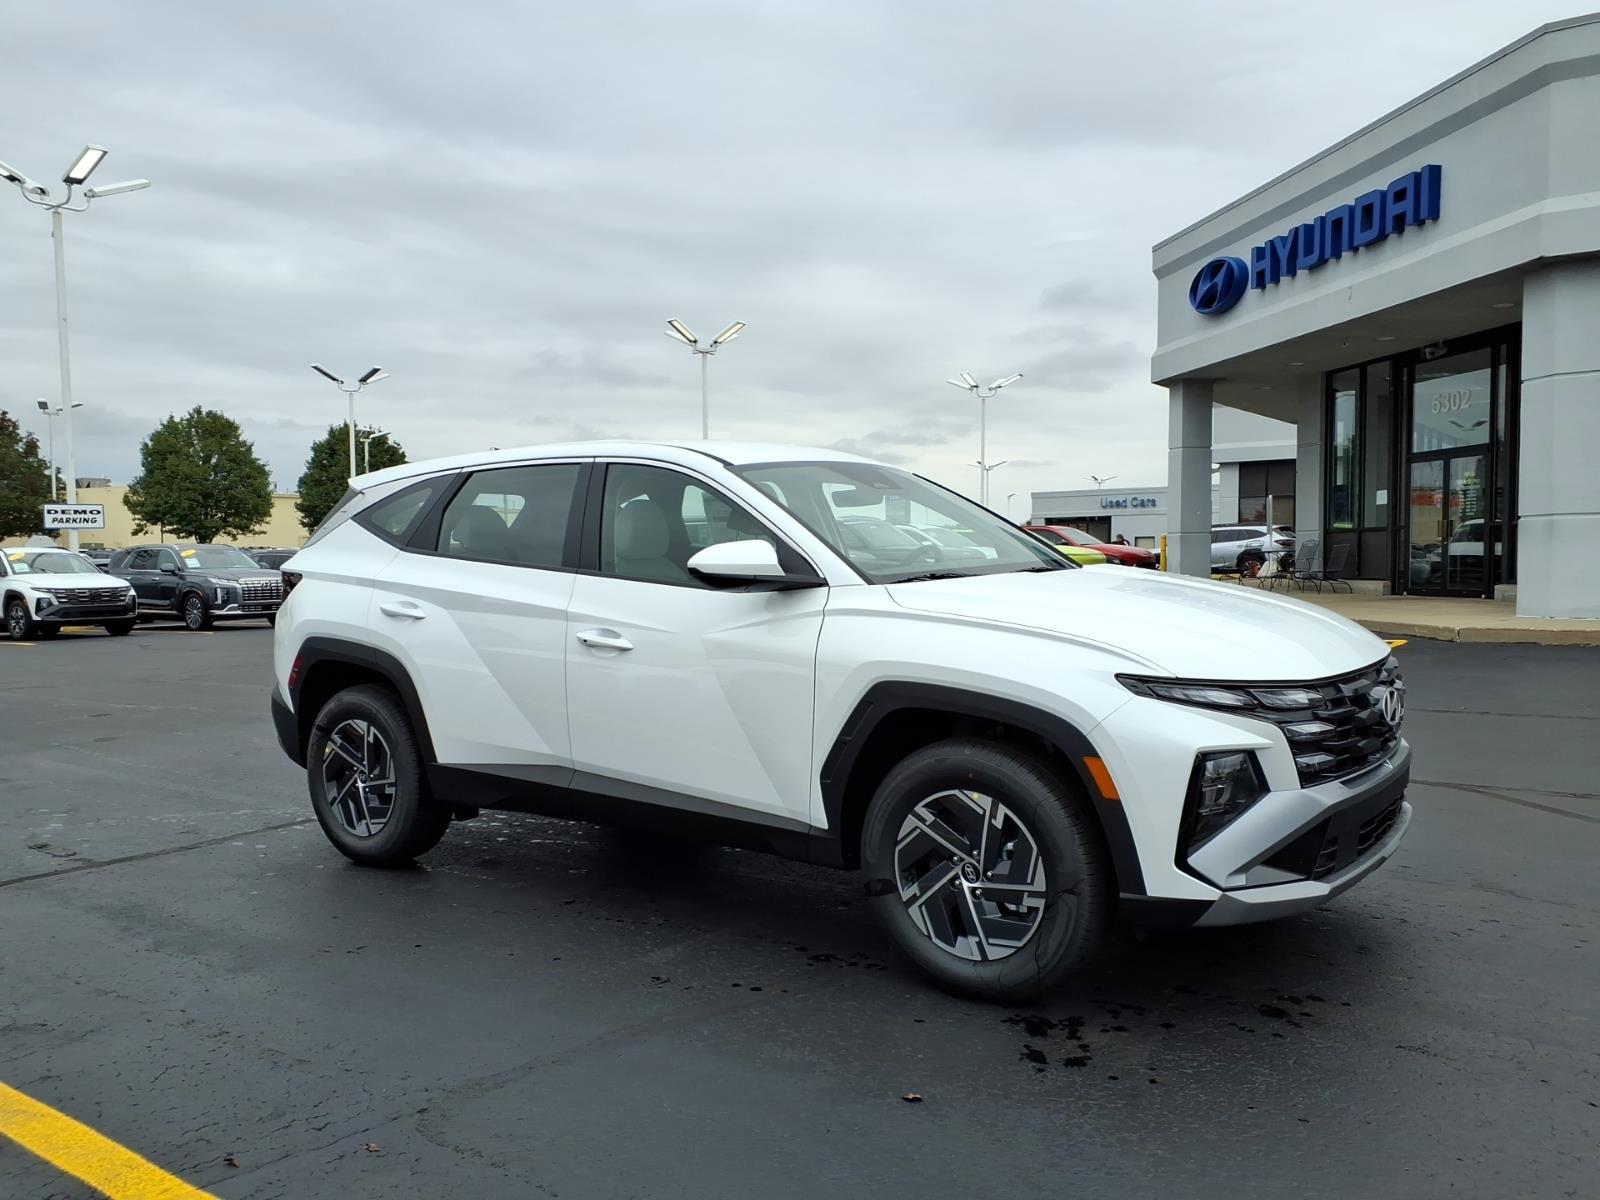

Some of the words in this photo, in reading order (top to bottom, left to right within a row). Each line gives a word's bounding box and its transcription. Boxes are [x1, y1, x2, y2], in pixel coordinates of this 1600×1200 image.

[1250, 164, 1442, 290] HYUNDAI
[1101, 497, 1128, 508] Used
[1130, 496, 1156, 508] Cars
